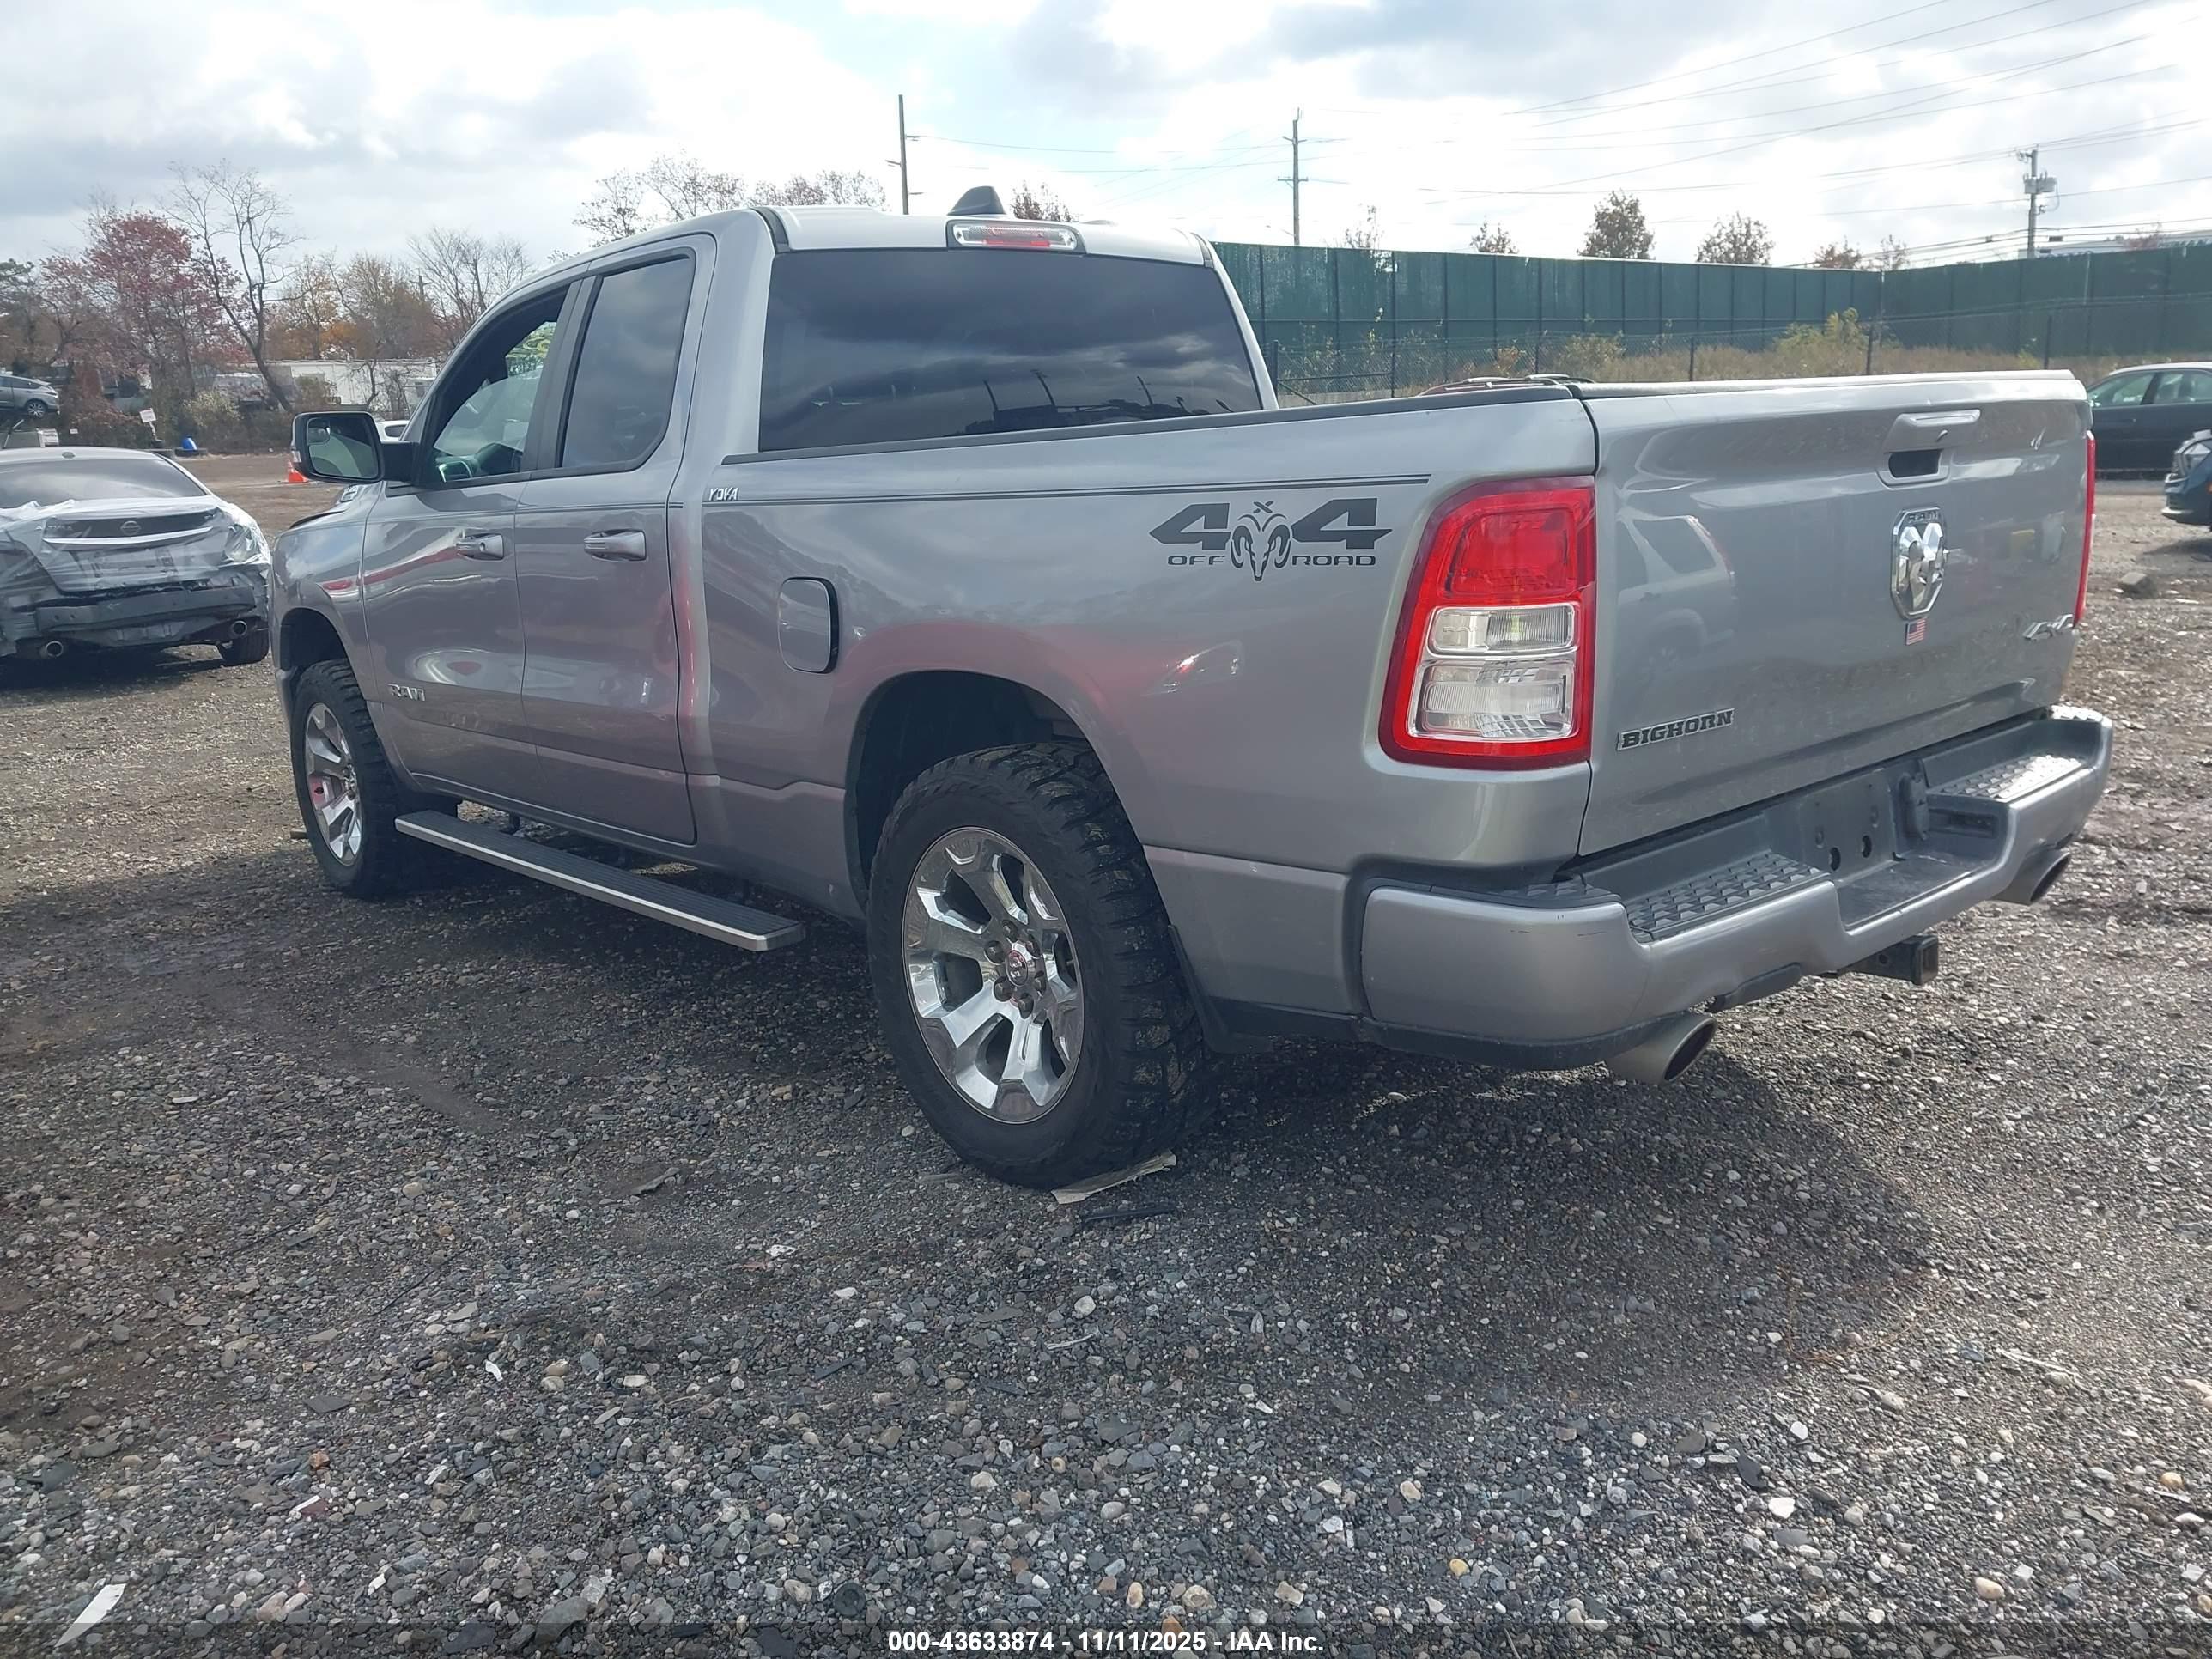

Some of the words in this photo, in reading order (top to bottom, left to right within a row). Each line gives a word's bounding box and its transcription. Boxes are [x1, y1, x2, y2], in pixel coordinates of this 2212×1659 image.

[1167, 555, 1226, 566] OFF
[1291, 555, 1376, 566] ROAD
[387, 683, 426, 702] RAM
[1618, 708, 1735, 750] BIGHORN
